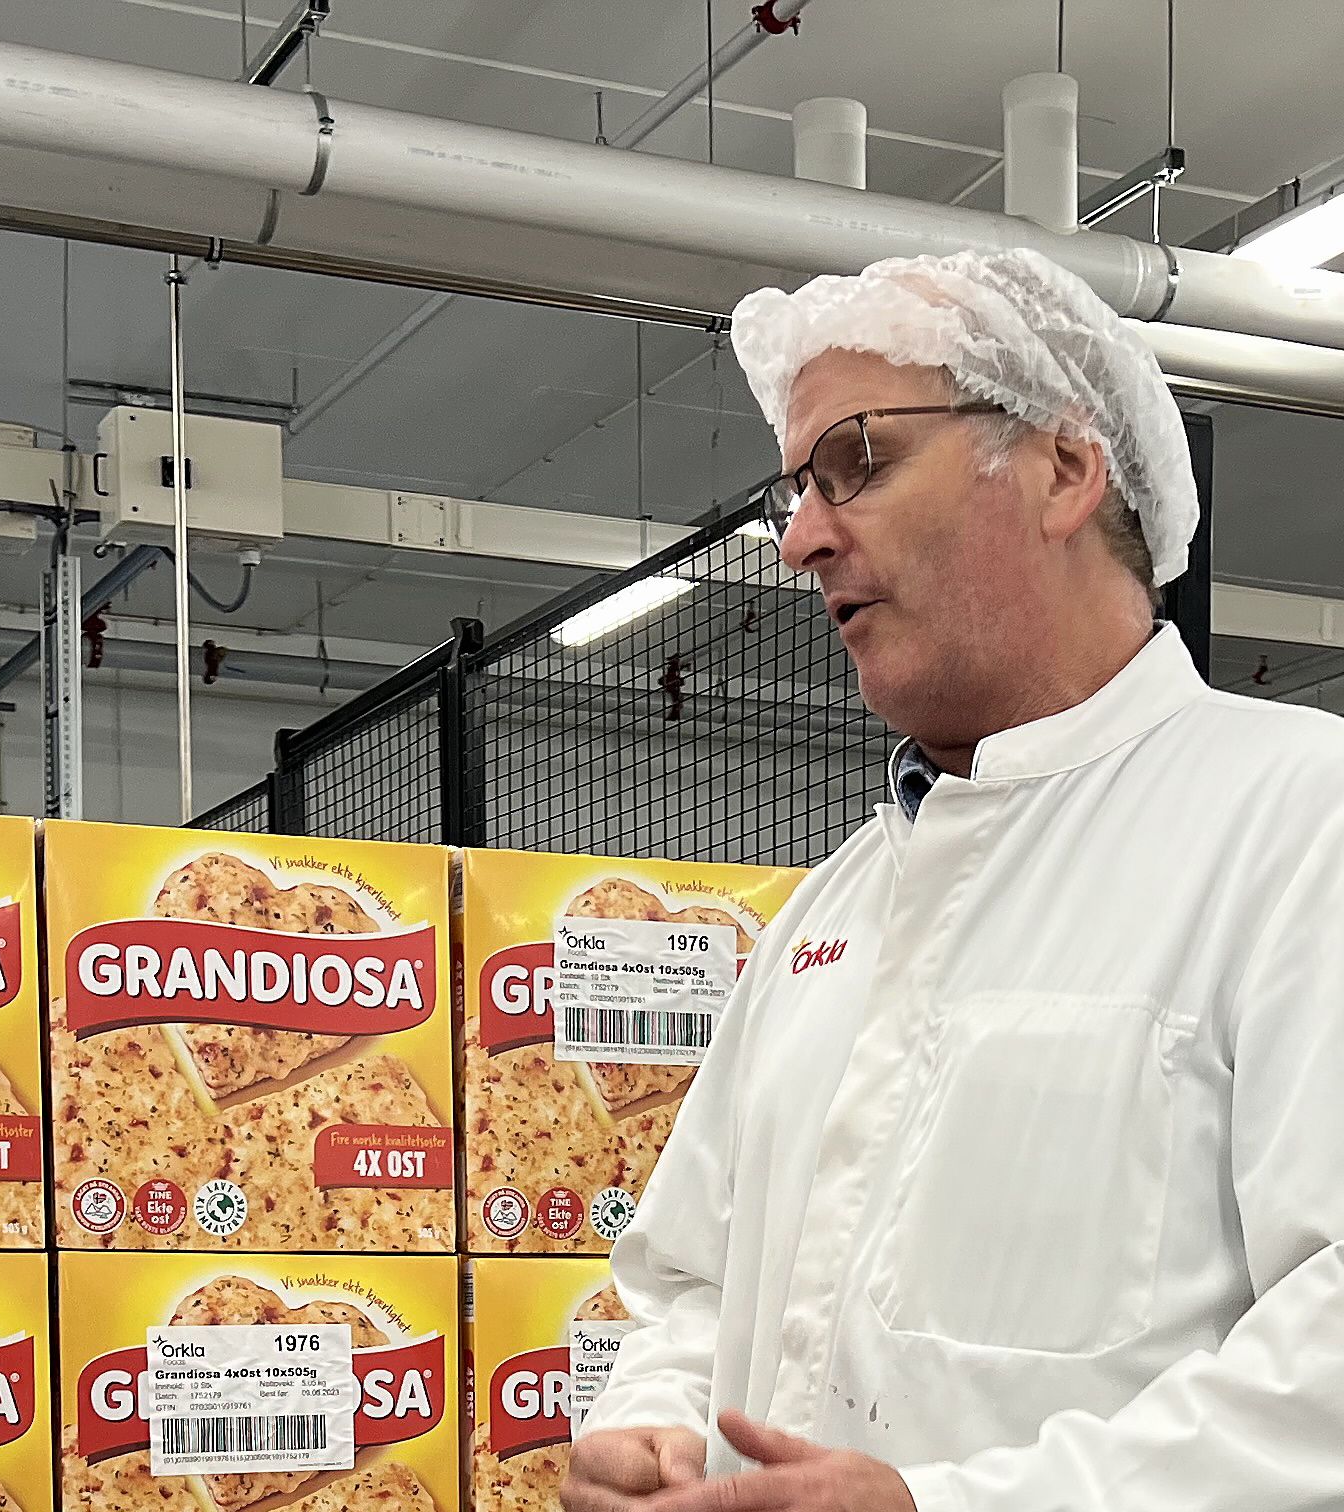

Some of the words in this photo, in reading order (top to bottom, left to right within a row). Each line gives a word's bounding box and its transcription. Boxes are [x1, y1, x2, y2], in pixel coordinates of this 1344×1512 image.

[269, 856, 282, 870] Vi
[332, 863, 353, 880] ekte
[356, 873, 402, 921] kjærlighet
[661, 881, 673, 894] Vi
[567, 935, 605, 950] Orkla
[668, 935, 708, 951] 1976
[560, 960, 618, 972] Grandiosa
[622, 963, 654, 974] 4xOst
[659, 966, 705, 978] 10x505g
[78, 942, 424, 1010] GRANDIOSA
[330, 1132, 350, 1146] Fire
[353, 1134, 382, 1146] norske
[385, 1134, 446, 1148] kvalitetsoster
[353, 1150, 382, 1176] 4X
[388, 1151, 426, 1178] OST
[207, 1182, 233, 1193] LAVT
[149, 1191, 172, 1199] TINE
[602, 1190, 625, 1200] LAVT
[148, 1202, 173, 1213] Ekte
[549, 1209, 572, 1219] Ekte
[151, 1214, 169, 1224] ost
[552, 1220, 568, 1229] ost
[280, 1276, 293, 1289] Vi
[342, 1279, 364, 1295] ekte
[274, 1335, 320, 1351] 1976
[582, 1338, 620, 1351] Orkla
[162, 1343, 204, 1357] Orkla
[156, 1370, 220, 1379] Grandiosa
[224, 1368, 261, 1378] 4xOst
[265, 1367, 317, 1378] 10x505g
[576, 1363, 613, 1372] Grand
